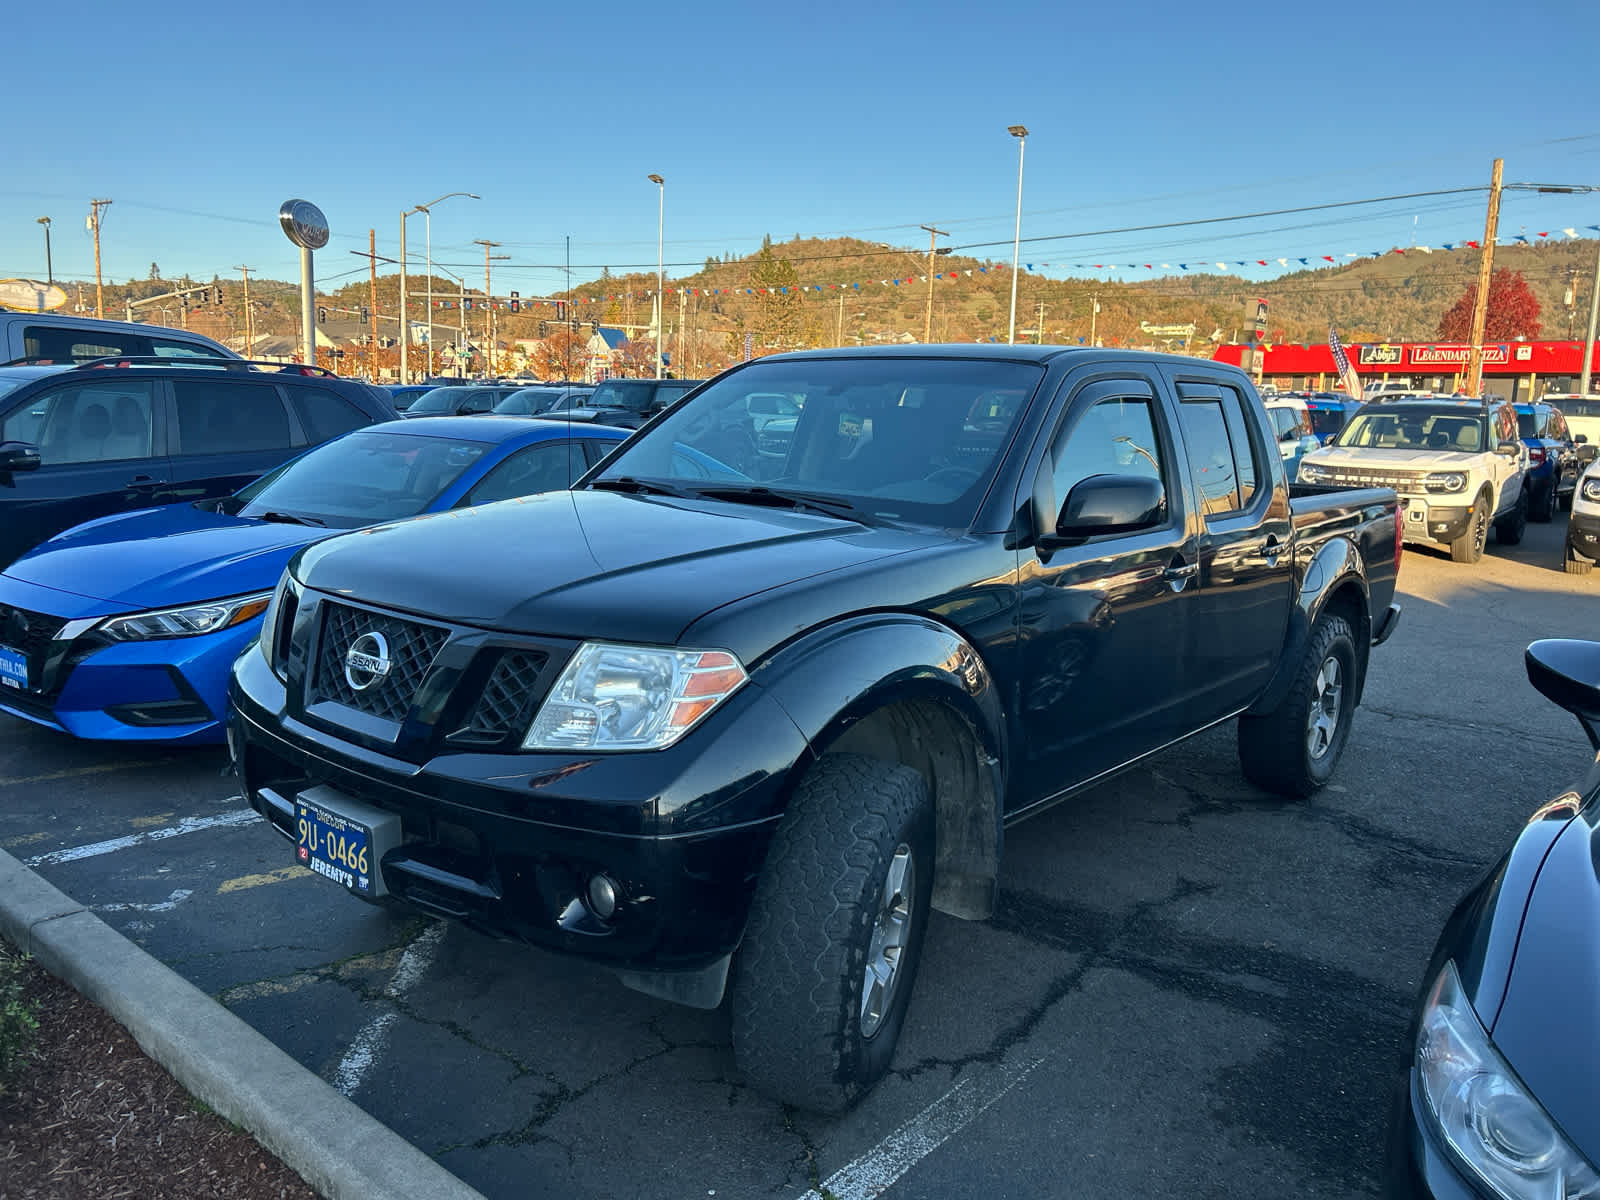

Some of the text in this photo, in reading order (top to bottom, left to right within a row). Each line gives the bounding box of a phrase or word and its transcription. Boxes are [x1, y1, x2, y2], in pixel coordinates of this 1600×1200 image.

[1415, 348, 1505, 361] LEGENDARY IZZA
[299, 818, 368, 875] 9U-0466
[310, 856, 354, 889] JEREMY'S
